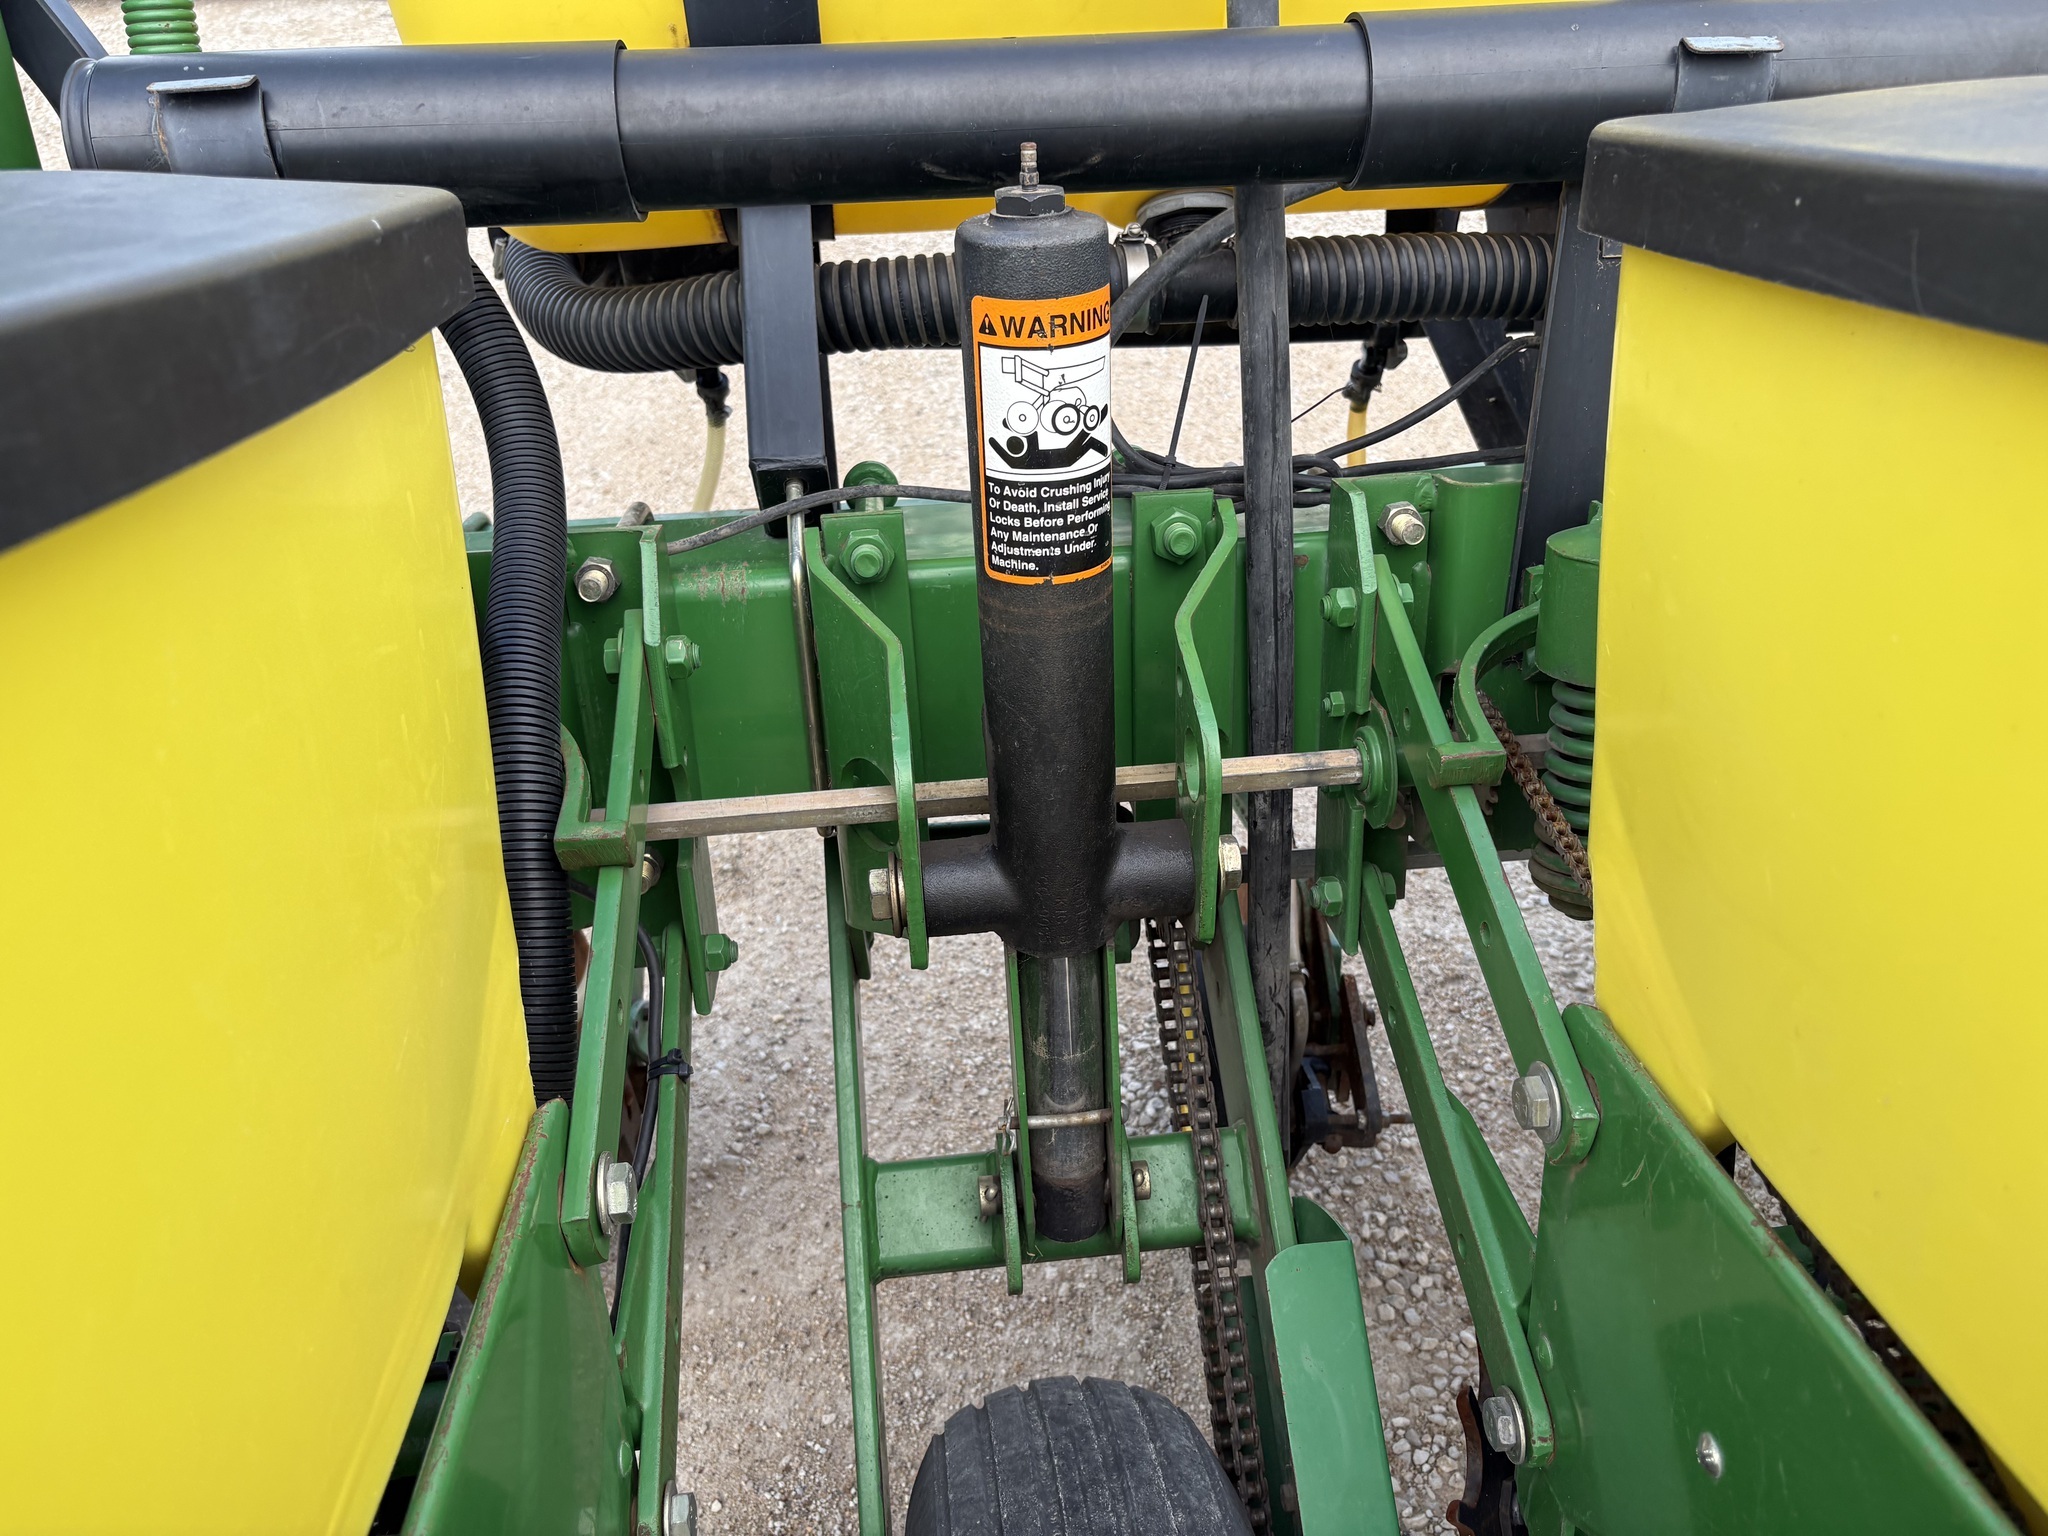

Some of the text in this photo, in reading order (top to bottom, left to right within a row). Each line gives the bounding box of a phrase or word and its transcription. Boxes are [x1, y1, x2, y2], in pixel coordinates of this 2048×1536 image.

[1000, 300, 1110, 338] WARNING
[988, 482, 1000, 494] To
[1003, 486, 1037, 498] Avoid
[1041, 482, 1092, 498] Crushing
[989, 498, 1000, 509] Or
[1003, 501, 1040, 514] Death,
[1043, 498, 1079, 513] Install
[989, 501, 1110, 528] Locks Before Performing
[990, 523, 1098, 542] Any Maintenance Or
[991, 541, 1061, 557] Adjustments
[991, 554, 1039, 571] Machine.
